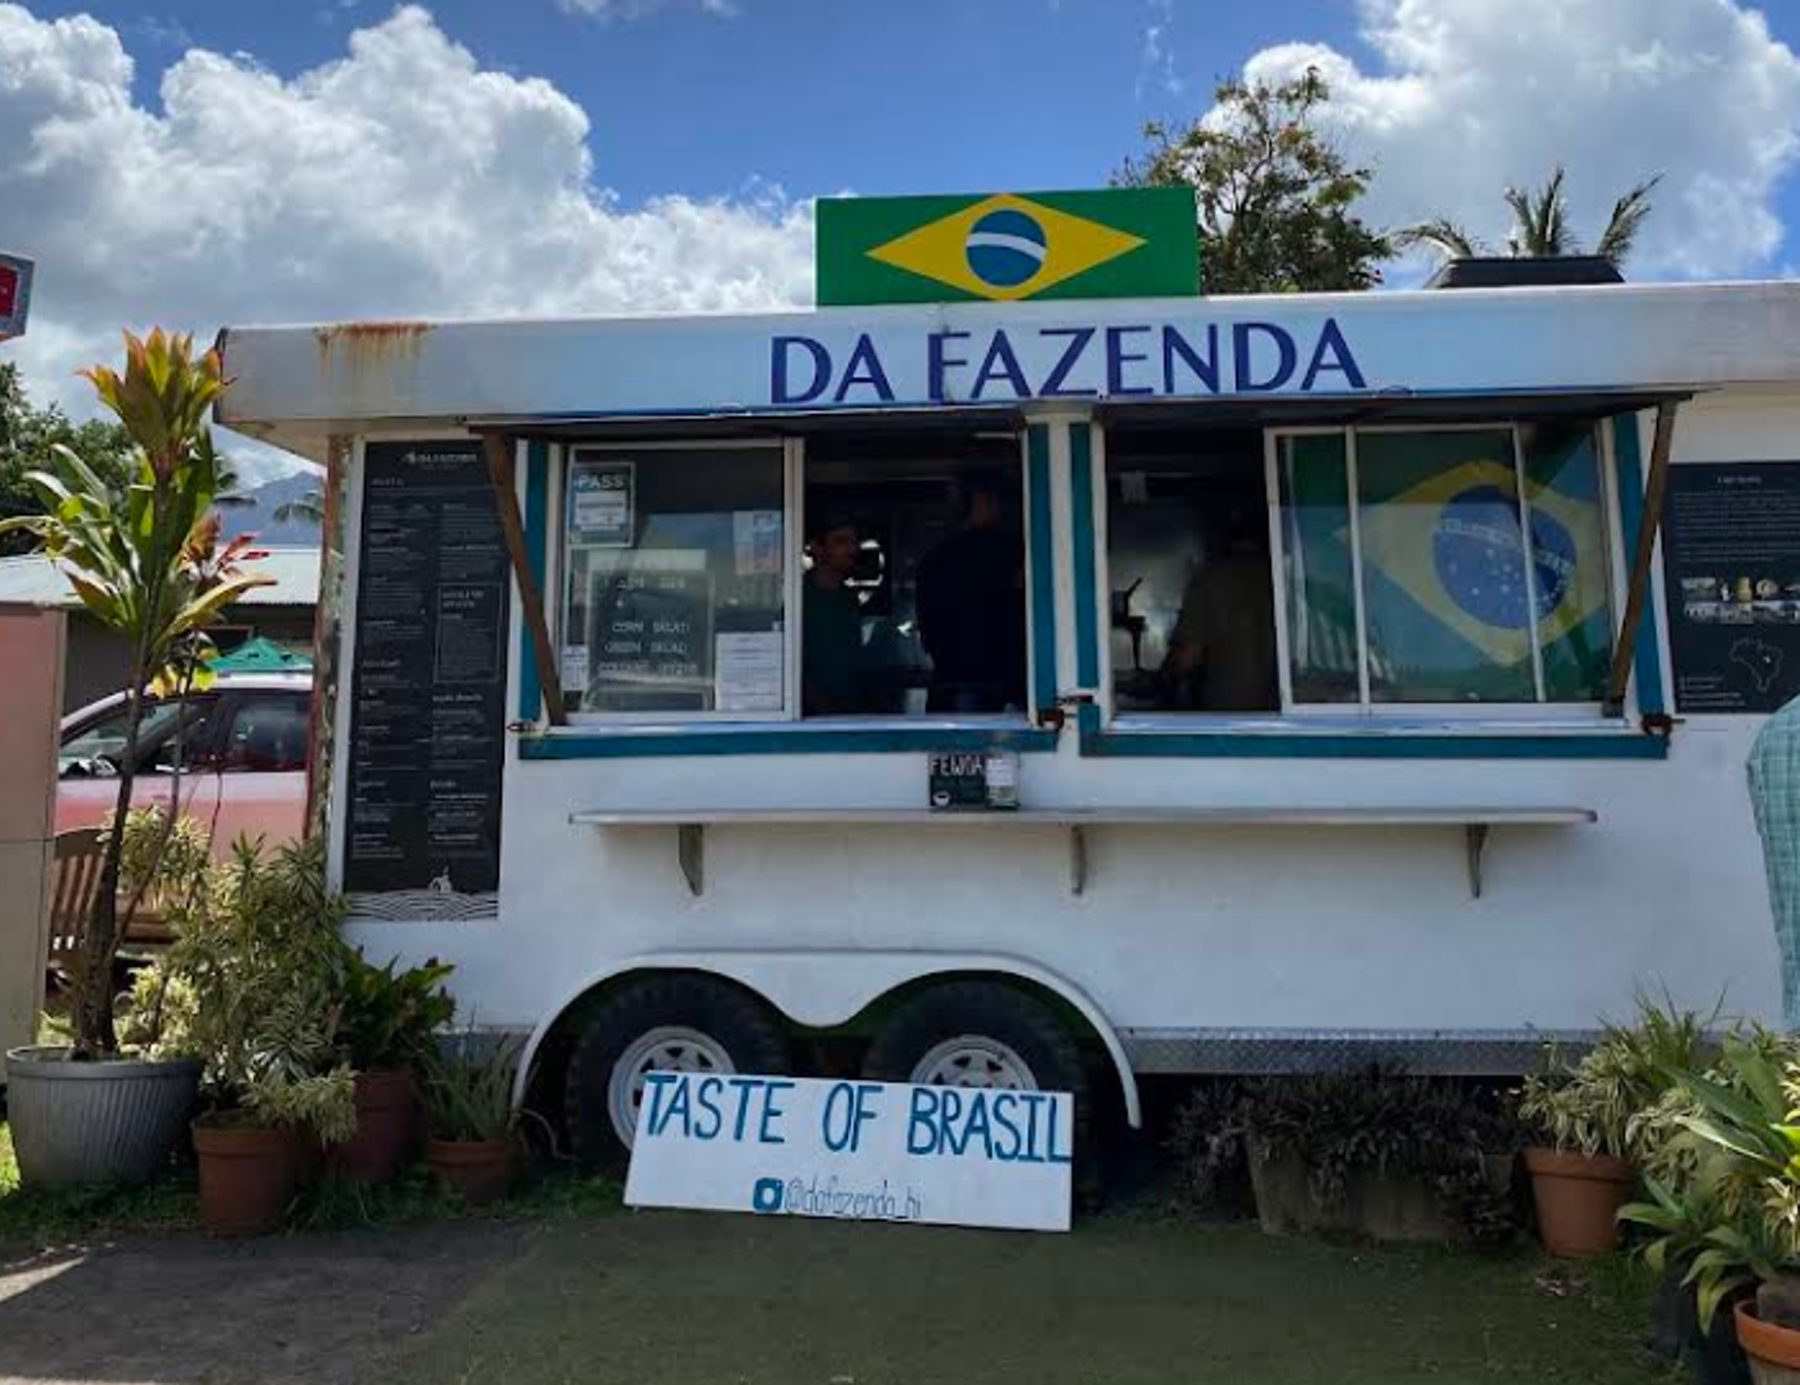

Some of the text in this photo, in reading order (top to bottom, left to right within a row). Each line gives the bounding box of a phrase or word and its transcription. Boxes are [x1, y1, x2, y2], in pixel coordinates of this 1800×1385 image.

[771, 318, 1367, 405] DA FAZENDA
[577, 474, 624, 489] PASS
[645, 1074, 1073, 1163] TASTE OF BRASIL
